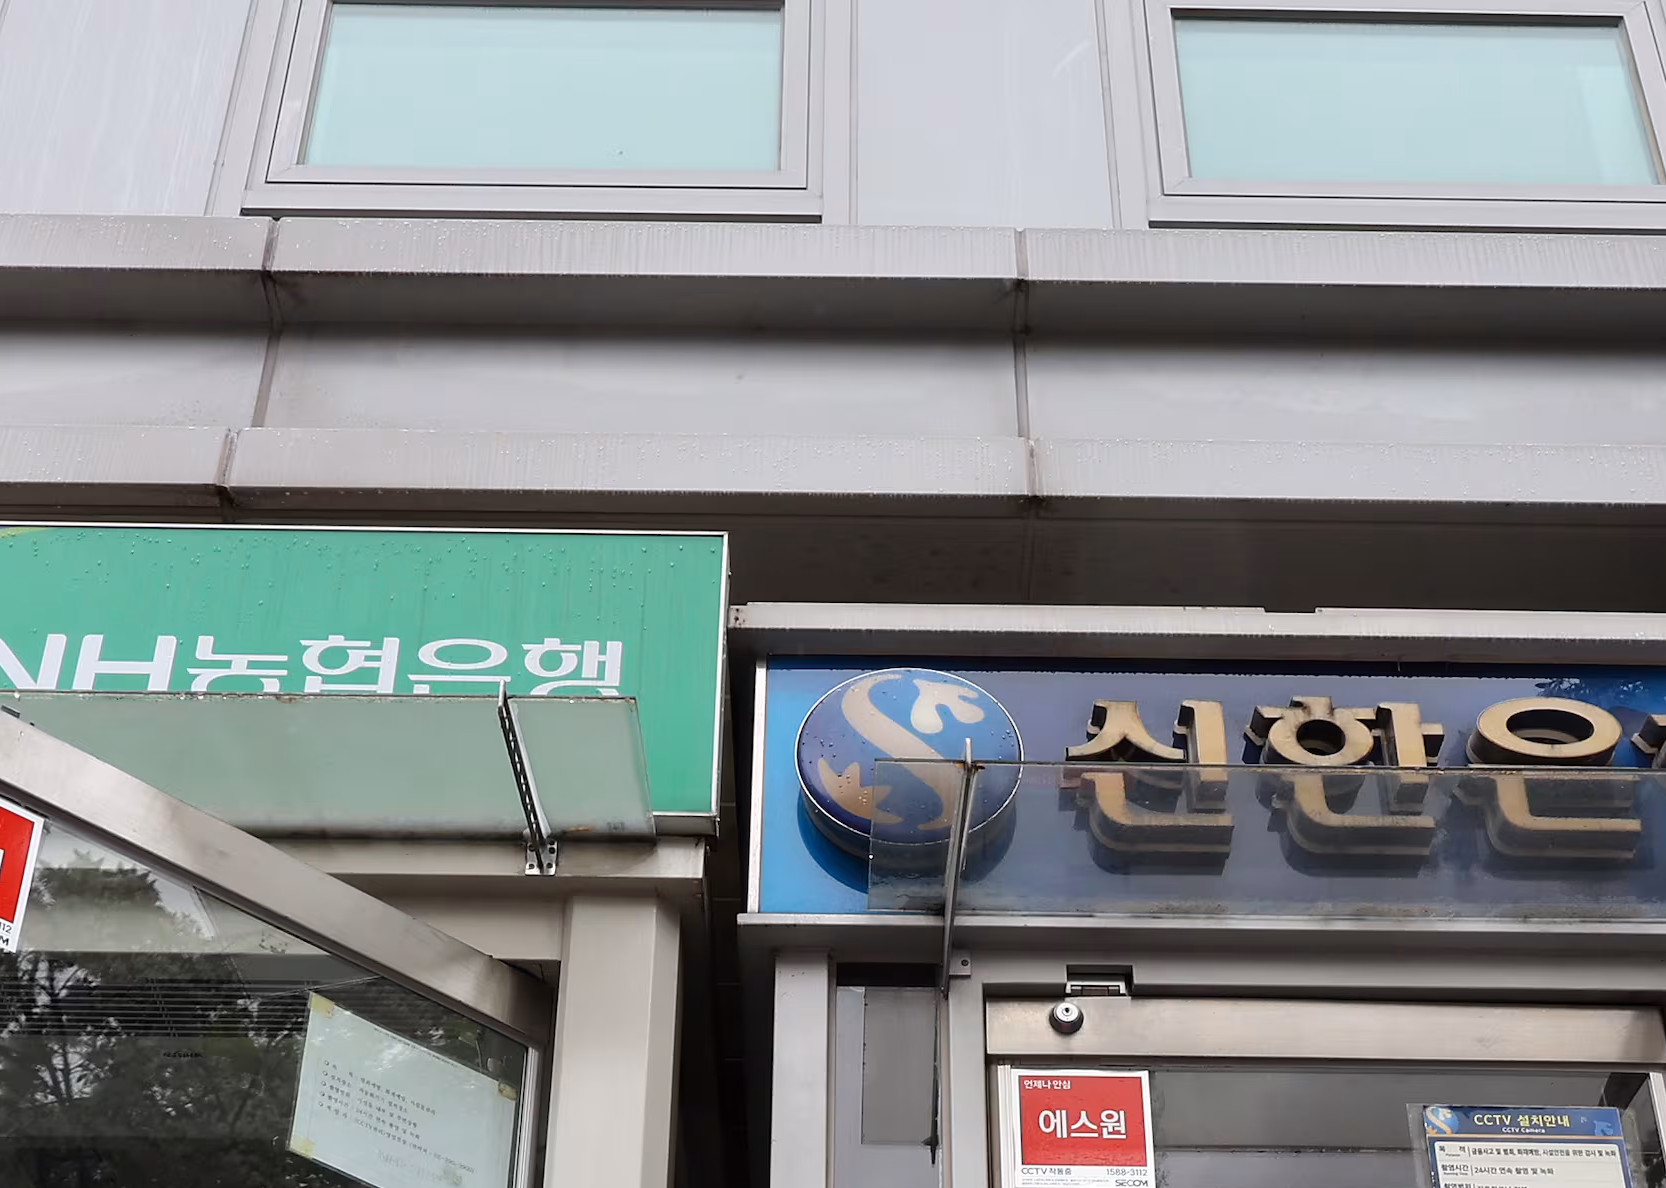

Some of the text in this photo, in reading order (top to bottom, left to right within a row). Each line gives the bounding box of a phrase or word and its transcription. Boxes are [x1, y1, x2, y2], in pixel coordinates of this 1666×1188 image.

[1024, 1079, 1071, 1090] 언제나 안심
[1038, 1109, 1127, 1139] 에스원
[1473, 1114, 1570, 1127] CCTV 설치안내
[1021, 1167, 1048, 1175] CCTV
[1106, 1168, 1148, 1176] 1588-3112
[1474, 1166, 1498, 1175] 24시간
[1115, 1179, 1149, 1187] SECOM
